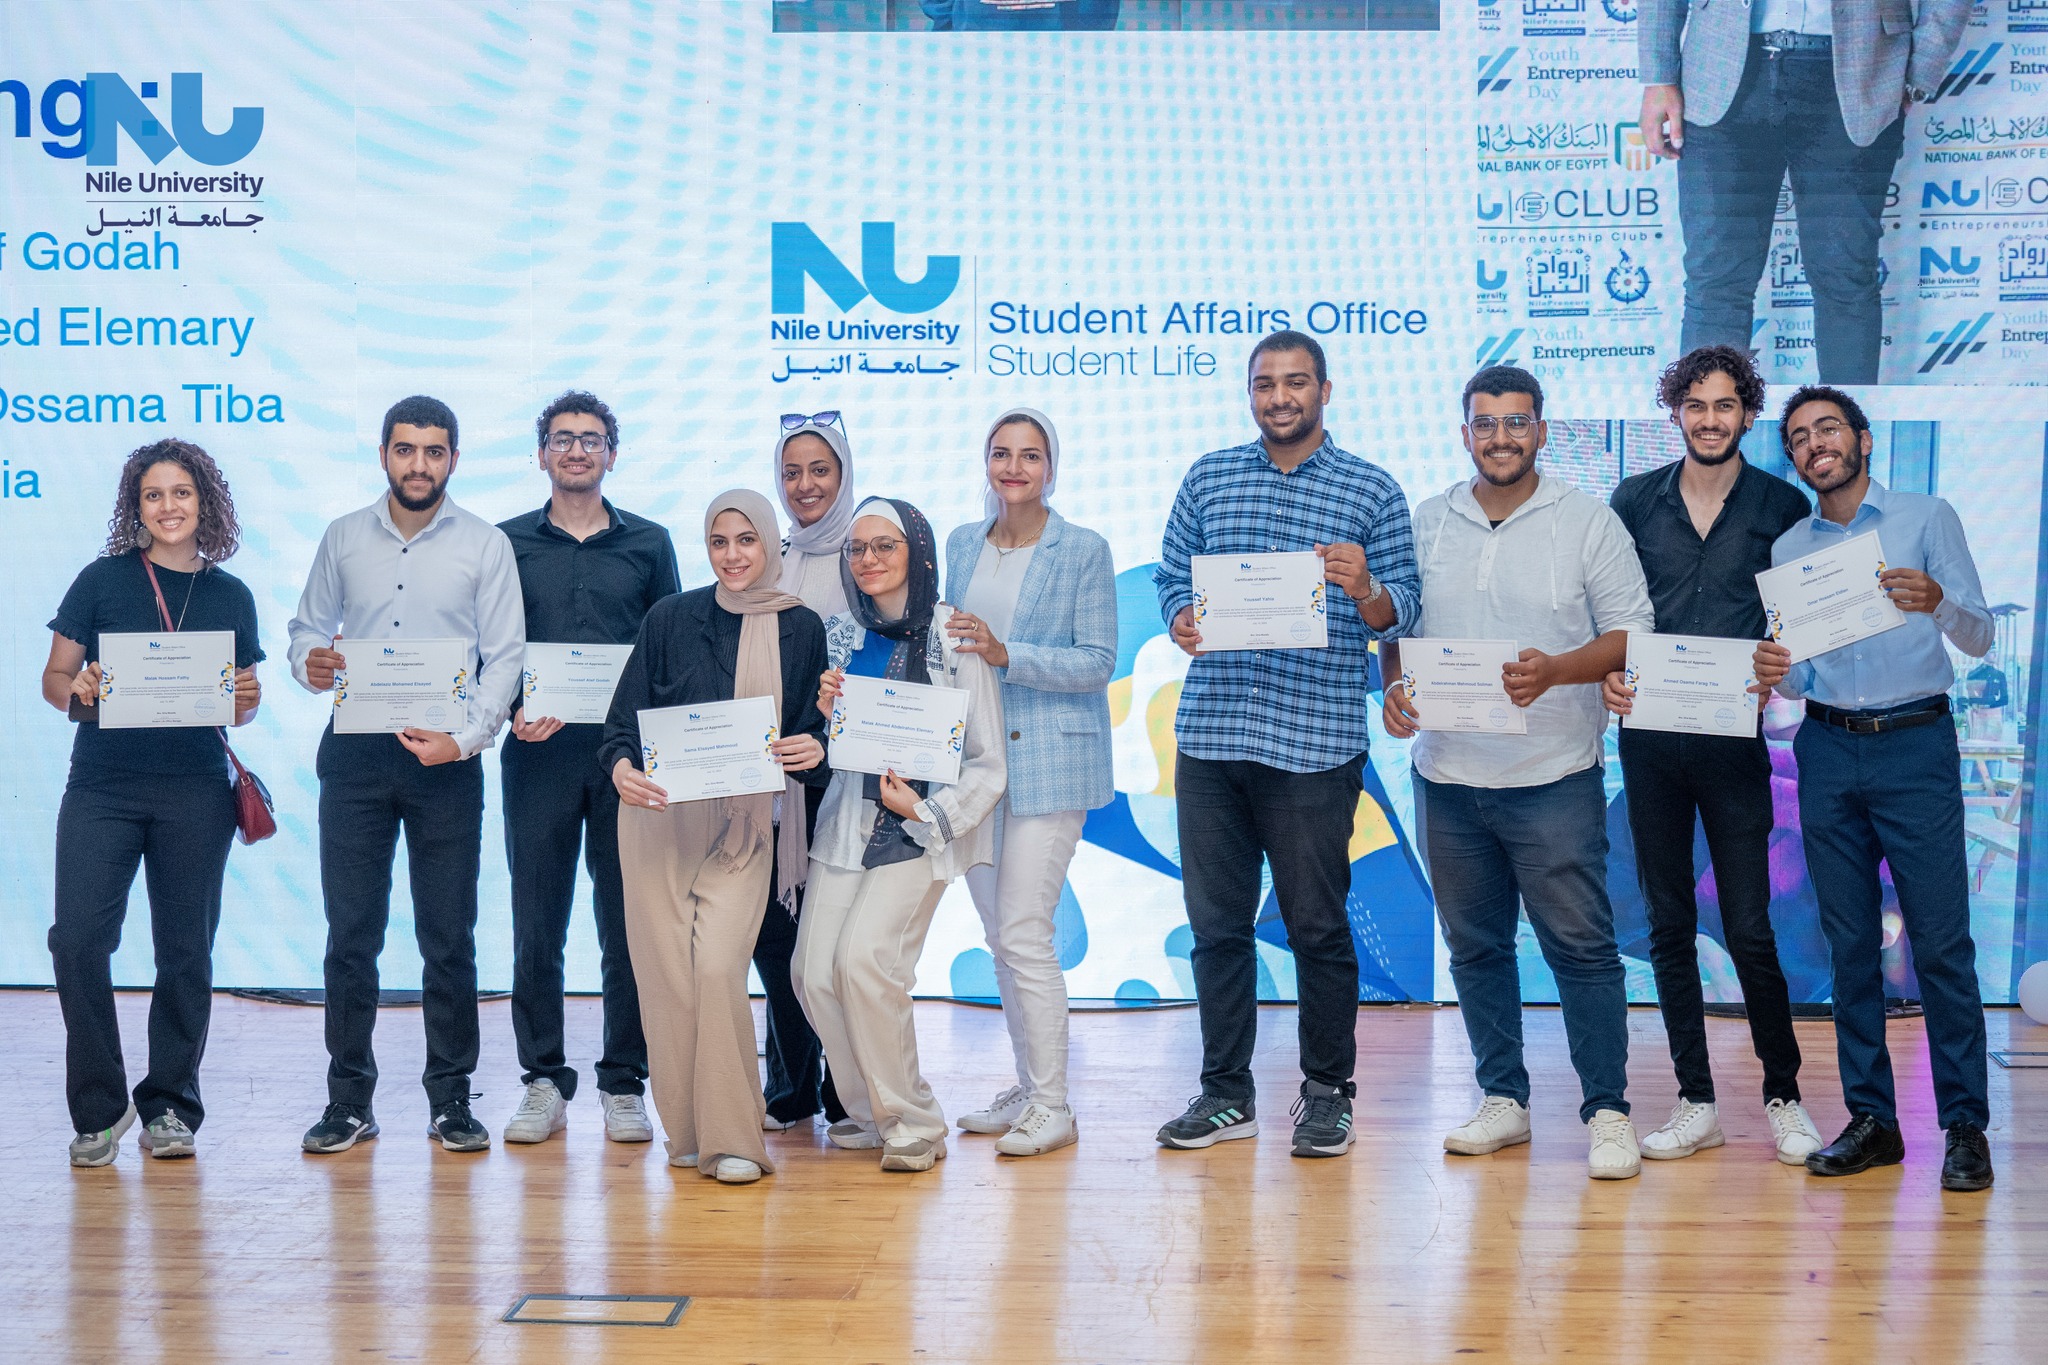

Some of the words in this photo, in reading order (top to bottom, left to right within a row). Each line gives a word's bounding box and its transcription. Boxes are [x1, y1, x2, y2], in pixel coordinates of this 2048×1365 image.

[1528, 46, 1580, 62] Youth
[1528, 85, 1561, 102] Day
[2010, 79, 2041, 97] Day
[1505, 160, 1541, 172] BANK
[1545, 160, 1561, 170] OF
[1566, 158, 1609, 170] EGYPT
[1925, 152, 1984, 163] NATIONAL
[1986, 149, 2017, 160] BANK
[2020, 148, 2036, 158] OF
[1554, 187, 1659, 218] CLUB
[1921, 180, 1980, 209] NU
[1477, 232, 1603, 244] repreneurship
[1611, 232, 1648, 242] Club
[1931, 220, 2048, 231] Entrepreneurs
[23, 231, 180, 271] Godah
[1920, 246, 1981, 276] NU
[772, 221, 960, 314] NU
[1537, 255, 1578, 280] رواد
[1528, 273, 1590, 298] النيل
[1919, 277, 1936, 285] Nile
[1938, 276, 1980, 286] University
[988, 302, 1147, 335] Student
[1163, 301, 1290, 334] Affairs
[1306, 301, 1428, 335] Office
[60, 306, 255, 357] Elemary
[771, 320, 821, 341] Nile
[827, 320, 960, 345] University
[1532, 325, 1584, 342] Youth
[988, 344, 1140, 378] Student
[1153, 343, 1217, 378] Life
[1532, 344, 1655, 362] Entrepreneurs
[1774, 354, 1807, 368] Day
[772, 355, 851, 383] النيل
[859, 355, 960, 381] جامعة
[1533, 364, 1566, 379] Day
[182, 383, 285, 424] Tiba
[1800, 577, 1818, 587] Certificate
[1822, 568, 1844, 579] Appreciation
